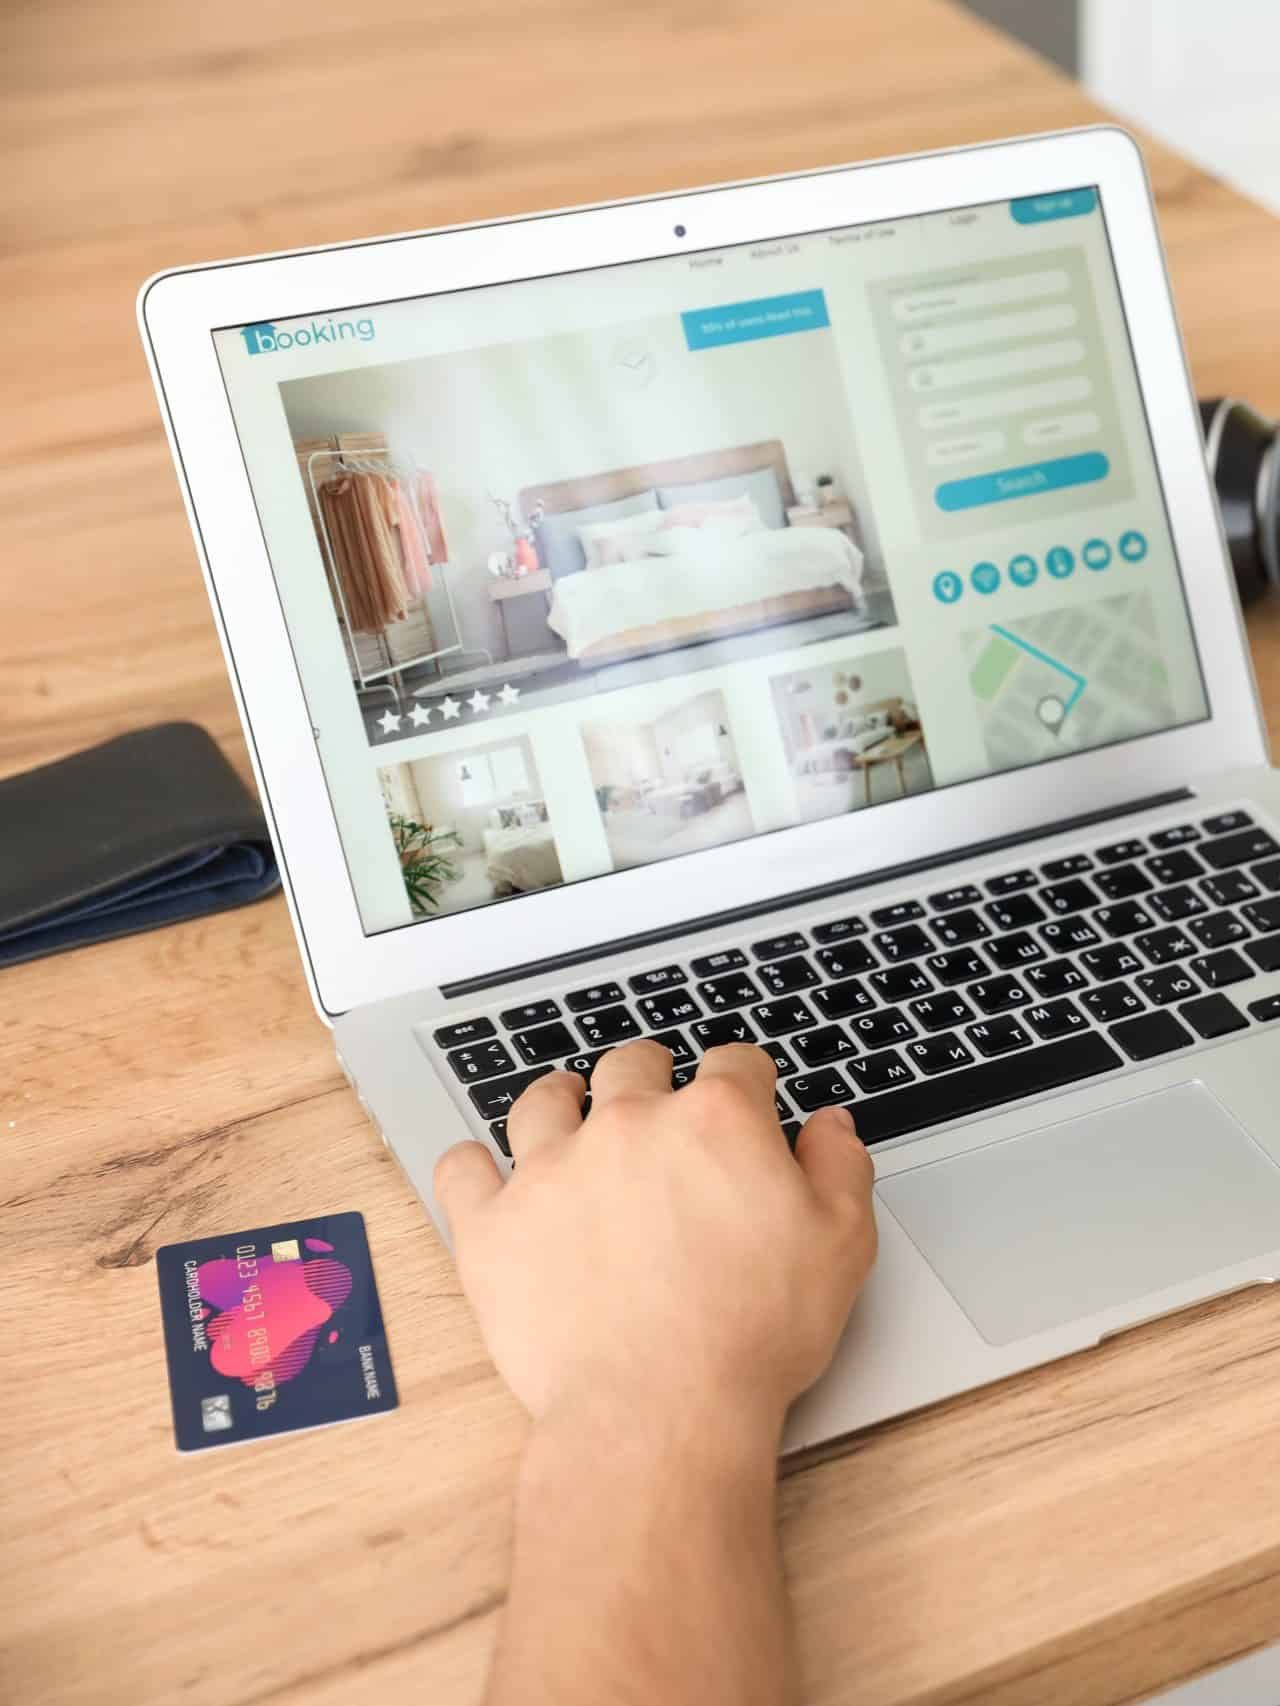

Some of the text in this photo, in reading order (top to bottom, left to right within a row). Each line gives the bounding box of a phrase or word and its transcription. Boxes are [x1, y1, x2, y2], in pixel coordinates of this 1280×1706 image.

[255, 317, 375, 352] booking
[996, 471, 1046, 494] Search
[454, 1024, 475, 1035] esc
[236, 1245, 258, 1278] 0123
[184, 1260, 208, 1352] CARDHOLDER NAME
[242, 1285, 265, 1321] 4567
[359, 1345, 380, 1400] BANK NAME
